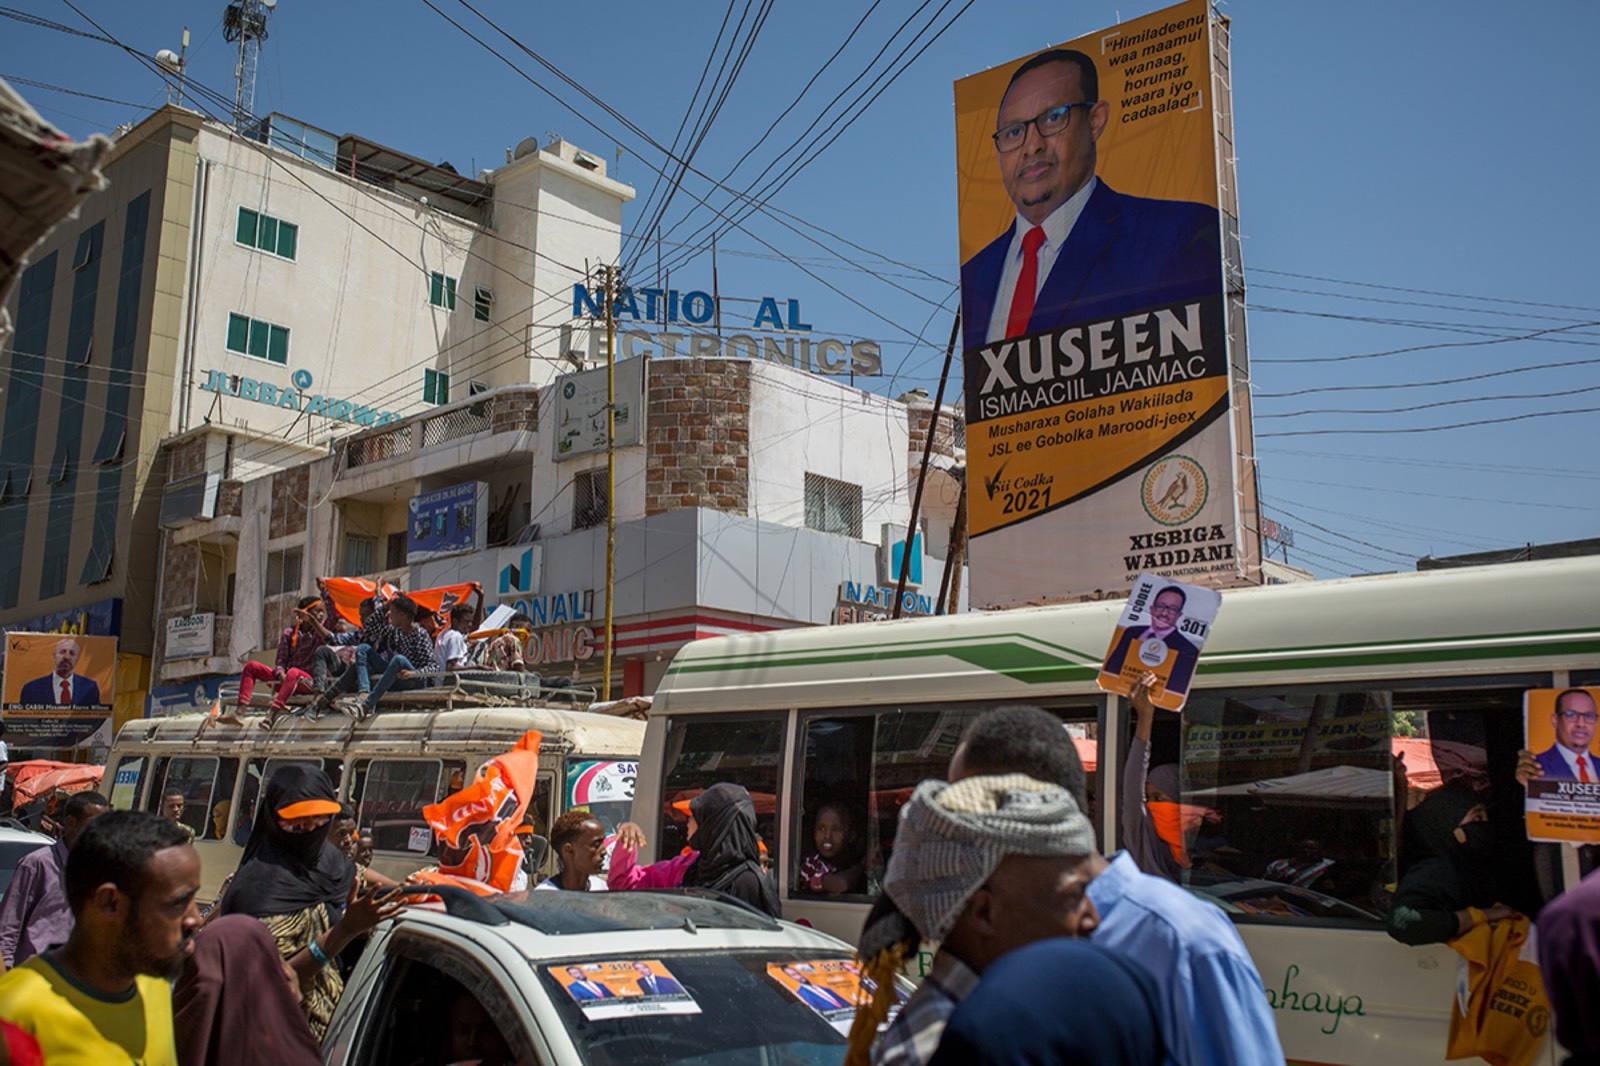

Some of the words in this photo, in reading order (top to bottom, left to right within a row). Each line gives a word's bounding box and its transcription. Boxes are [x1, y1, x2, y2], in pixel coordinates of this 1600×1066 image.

[1109, 50, 1137, 67] waa
[1142, 28, 1202, 57] maamul
[1124, 52, 1185, 77] wanaag,
[1124, 65, 1189, 92] horumar
[1121, 88, 1165, 108] waara
[1170, 80, 1193, 97] iyo
[979, 303, 1204, 395] XUSEEN
[200, 369, 300, 411] JUBBA
[980, 380, 1093, 419] ISMAACIIL
[1100, 355, 1207, 395] JAAMAC
[988, 415, 1060, 439] Musharaxa
[1064, 405, 1115, 424] Golaha
[1120, 390, 1193, 413] Wakiilada
[988, 443, 1013, 458] JSL
[1016, 440, 1032, 452] ee
[1036, 428, 1093, 448] Gobolka
[1098, 410, 1197, 437] Maroodi-jeex
[1014, 473, 1054, 489] Codka
[1003, 486, 1051, 514] 2021
[1129, 524, 1226, 551] XISBIGA
[1124, 544, 1234, 571] WADDANI
[1173, 565, 1208, 576] NATIONAL
[1210, 562, 1234, 572] PARTY
[1127, 613, 1140, 622] U
[1180, 619, 1208, 637] 301
